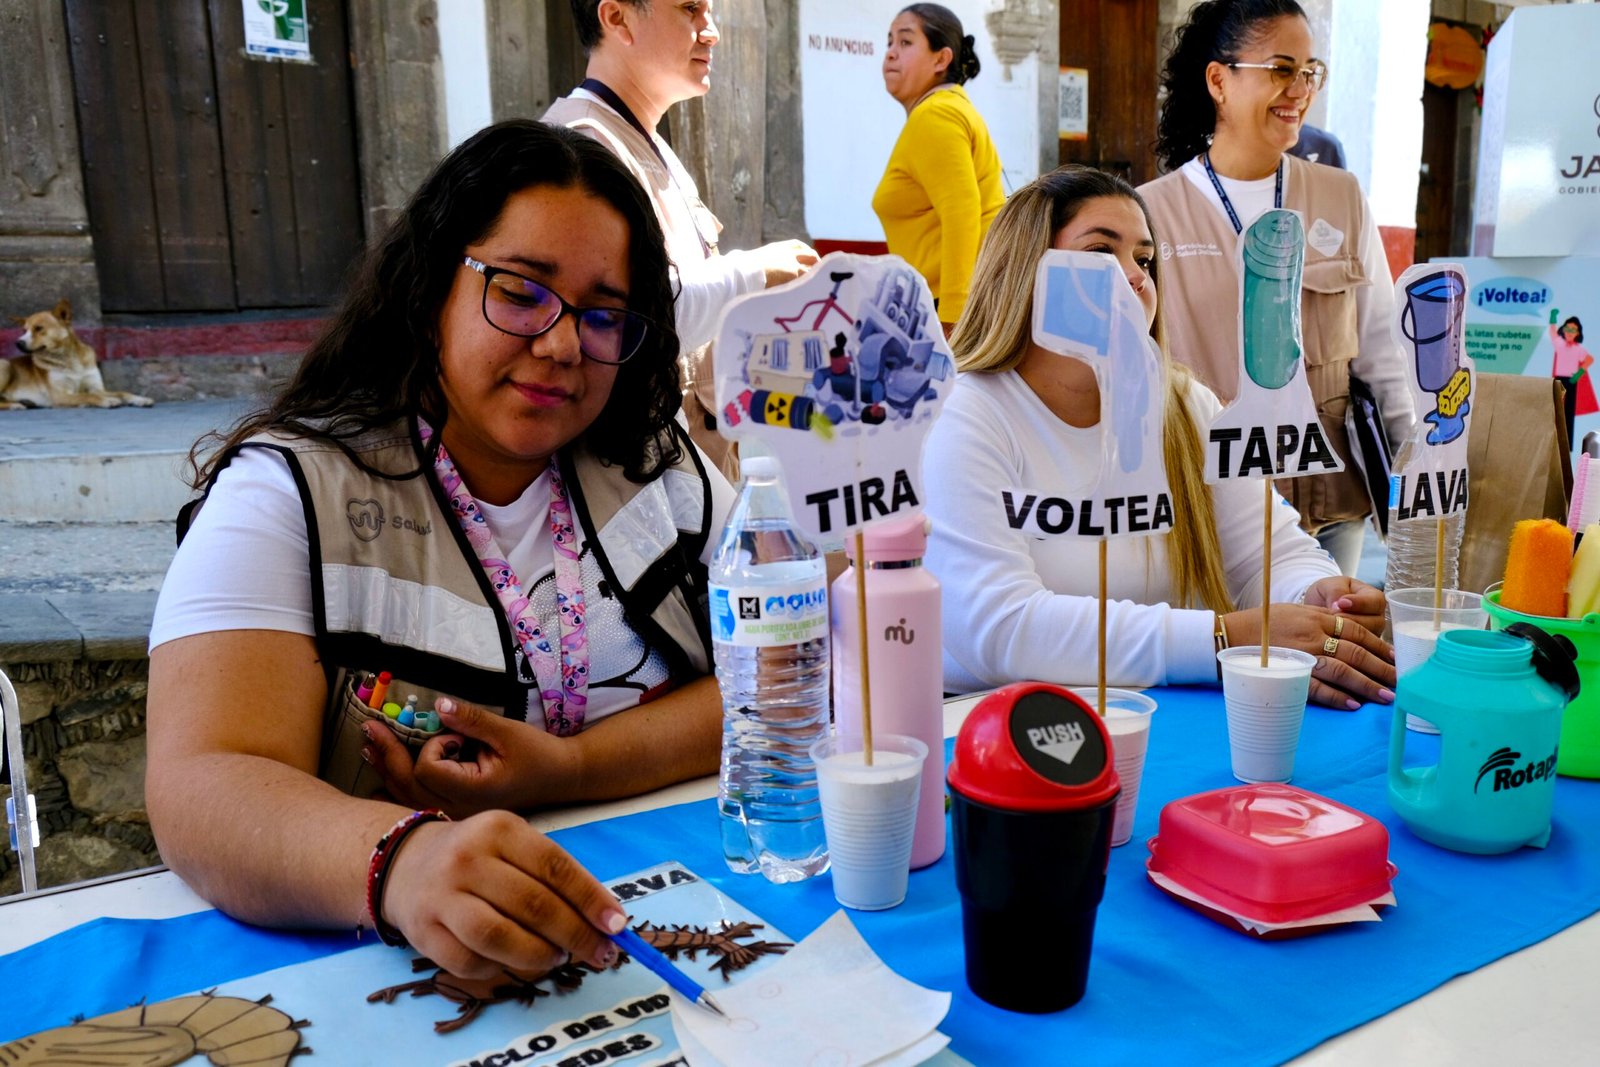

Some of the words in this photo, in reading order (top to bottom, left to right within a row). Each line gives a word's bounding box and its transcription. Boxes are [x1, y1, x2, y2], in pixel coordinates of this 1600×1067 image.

[808, 34, 822, 50] NO
[1559, 186, 1600, 194] GOBIE
[1478, 287, 1547, 306] ¡Voltea!
[1482, 342, 1497, 350] que
[1497, 331, 1532, 339] cubetas
[1209, 422, 1338, 478] TAPA
[805, 469, 920, 533] TIRA
[1397, 468, 1467, 521] LAVA
[1001, 490, 1174, 536] VOLTEA
[1027, 721, 1086, 748] PUSH
[611, 869, 696, 900] RVA
[562, 1014, 614, 1040] DE
[613, 993, 671, 1019] VID
[556, 1033, 653, 1067] EDES
